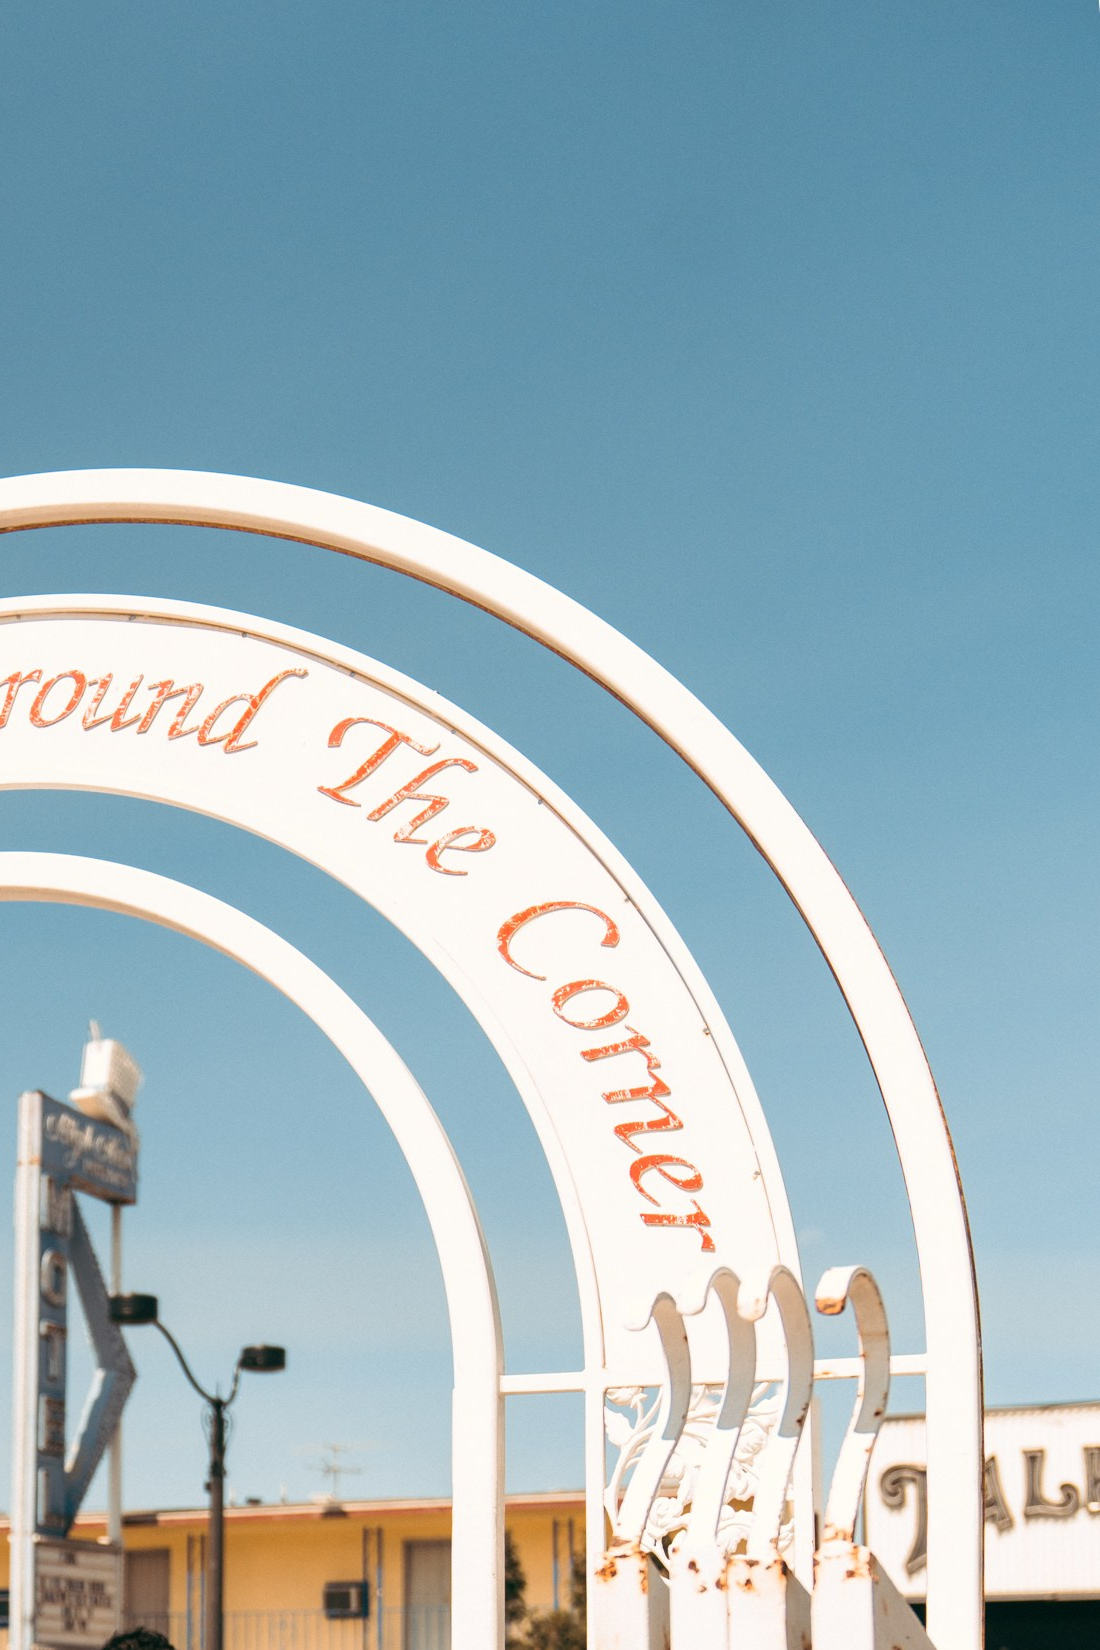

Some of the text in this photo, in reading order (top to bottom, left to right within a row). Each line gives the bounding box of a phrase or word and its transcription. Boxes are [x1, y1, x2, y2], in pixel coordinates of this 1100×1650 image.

[316, 716, 498, 876] The
[496, 900, 717, 1254] Corner
[37, 1173, 74, 1529] MOTEL
